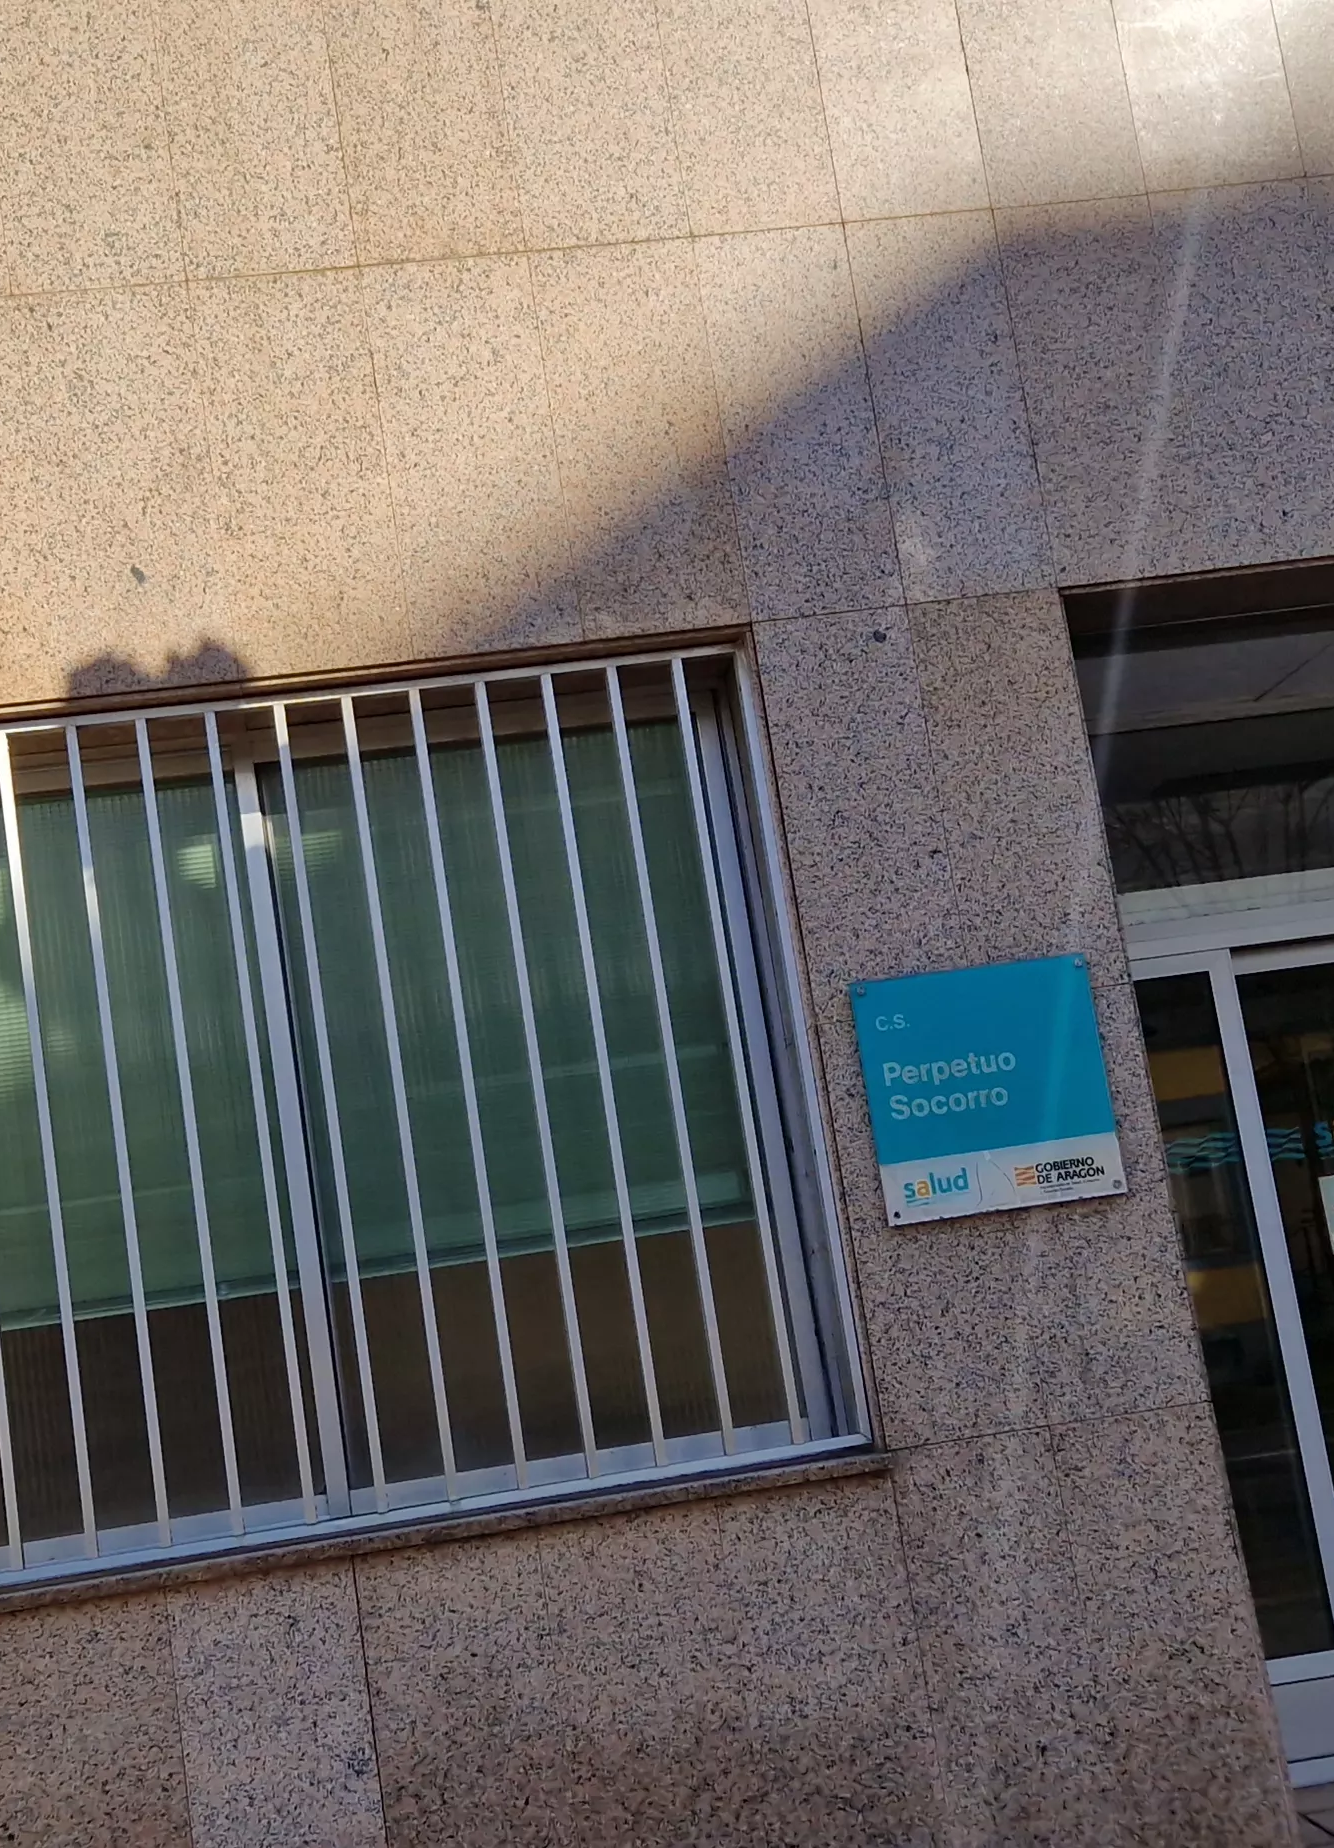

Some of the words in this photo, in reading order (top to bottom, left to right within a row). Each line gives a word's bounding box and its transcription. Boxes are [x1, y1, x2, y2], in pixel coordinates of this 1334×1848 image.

[875, 1013, 911, 1032] C.S.
[882, 1051, 1016, 1087] Perpetuo
[889, 1086, 1009, 1120] Socorro
[1035, 1156, 1095, 1173] GOBIERNO
[903, 1167, 970, 1199] salud
[1036, 1173, 1053, 1185] DE
